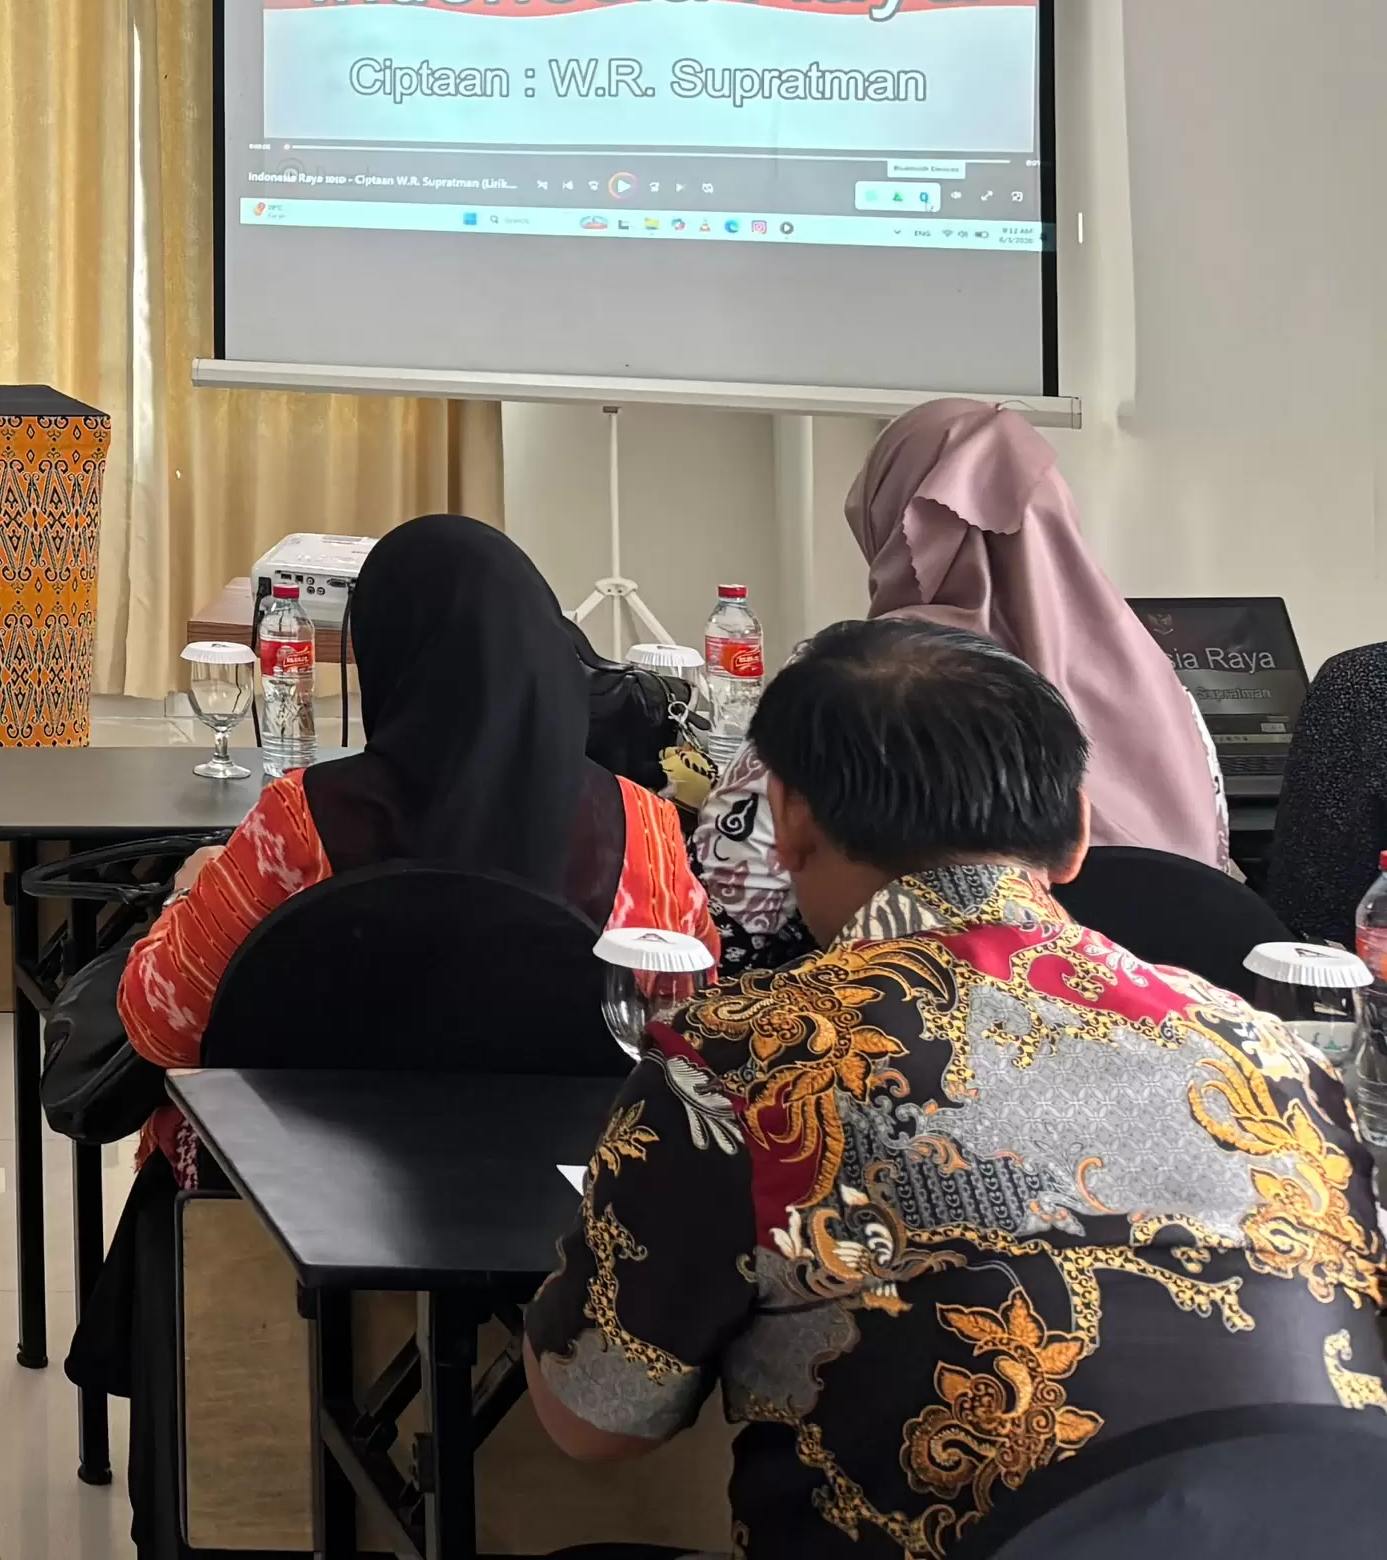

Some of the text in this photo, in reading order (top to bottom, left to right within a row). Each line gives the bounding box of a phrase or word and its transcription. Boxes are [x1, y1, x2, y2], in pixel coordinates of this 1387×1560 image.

[349, 56, 927, 107] Ciptaan : W.R. Supratman
[298, 173, 324, 186] Raya
[354, 174, 394, 188] Ciptaan
[396, 175, 420, 187] W.R.
[422, 176, 480, 190] Supratman
[1205, 647, 1276, 673] Raya
